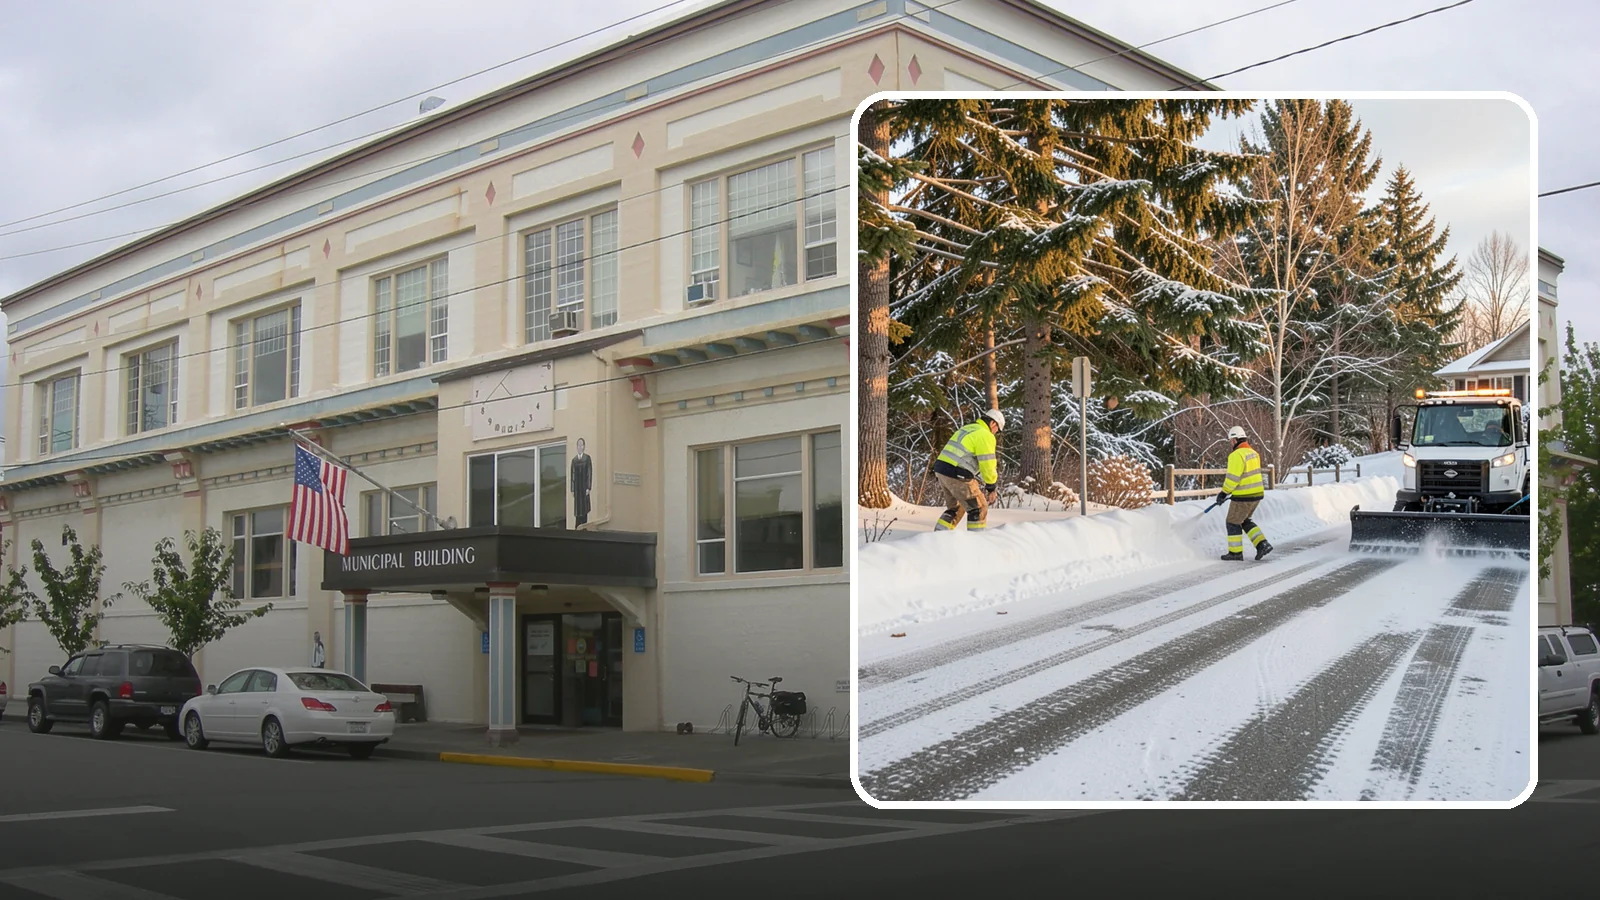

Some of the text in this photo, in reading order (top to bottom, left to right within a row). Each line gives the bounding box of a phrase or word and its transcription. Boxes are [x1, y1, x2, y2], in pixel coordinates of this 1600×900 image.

[481, 407, 485, 415] 8
[488, 418, 492, 426] 9
[508, 425, 513, 433] 12
[521, 420, 525, 428] 2
[529, 414, 533, 422] 3
[536, 402, 540, 410] 4
[342, 546, 475, 571] MUNICIPAL BUILDING
